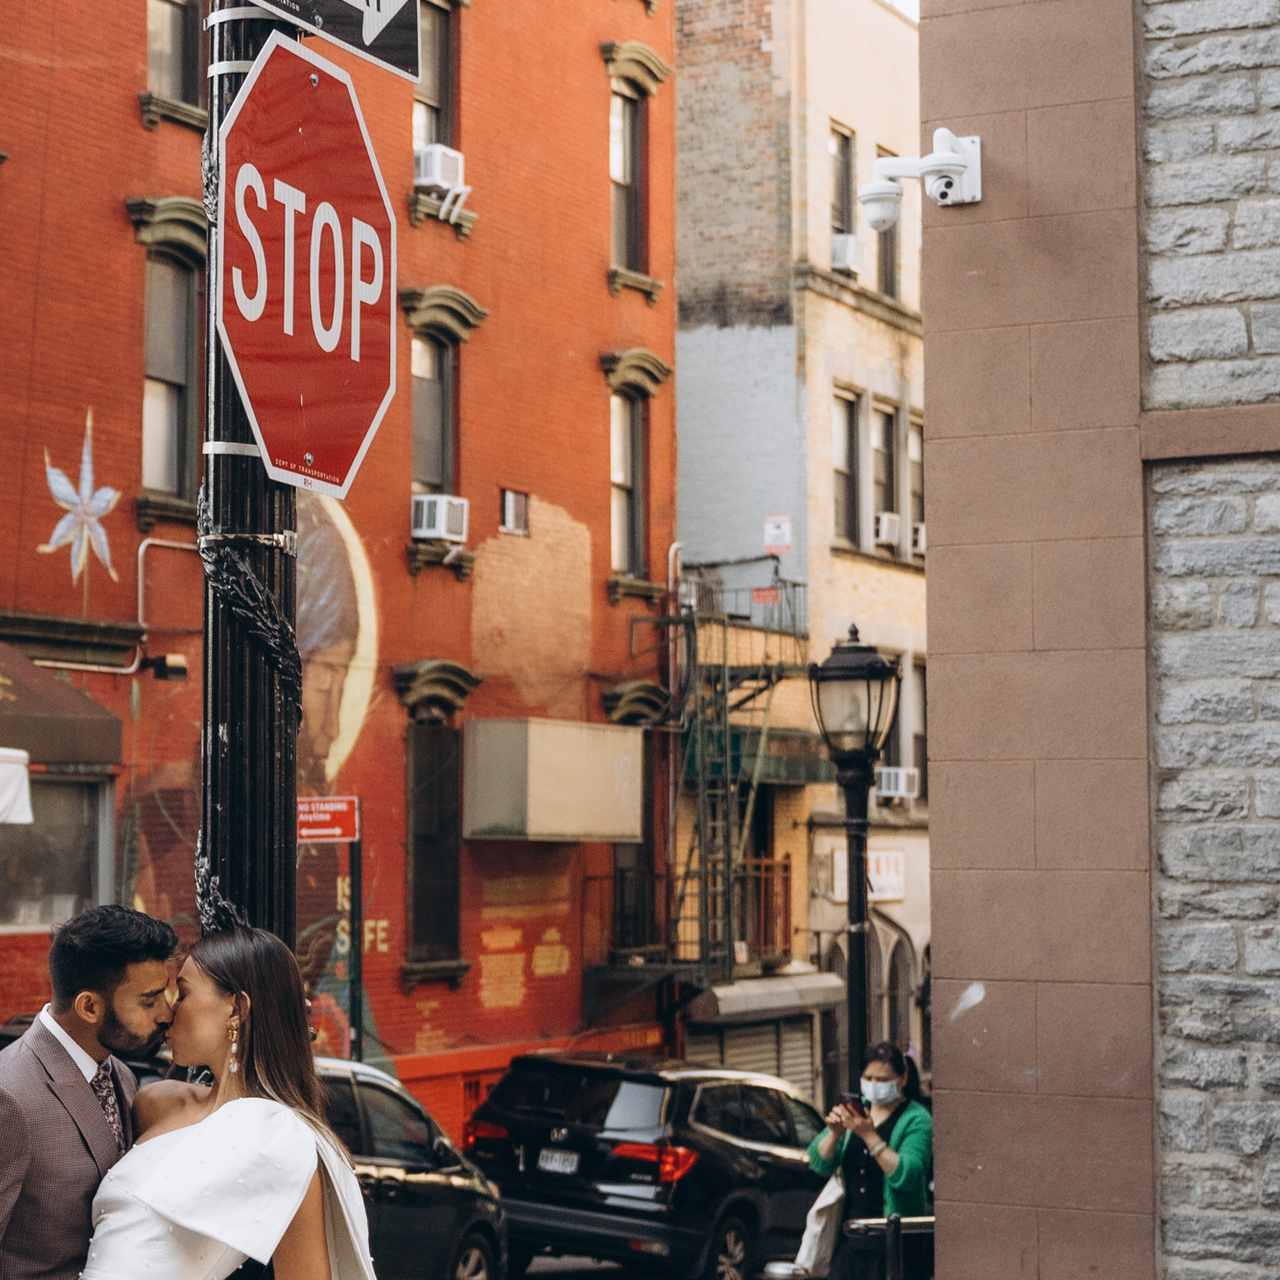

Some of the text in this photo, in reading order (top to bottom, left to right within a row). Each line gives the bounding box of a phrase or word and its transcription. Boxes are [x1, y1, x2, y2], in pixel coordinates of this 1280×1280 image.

[232, 162, 385, 363] STOP
[275, 458, 340, 483] DEPT OF TRANSPORTATION
[311, 802, 348, 811] STANDING
[336, 918, 389, 954] SFE
